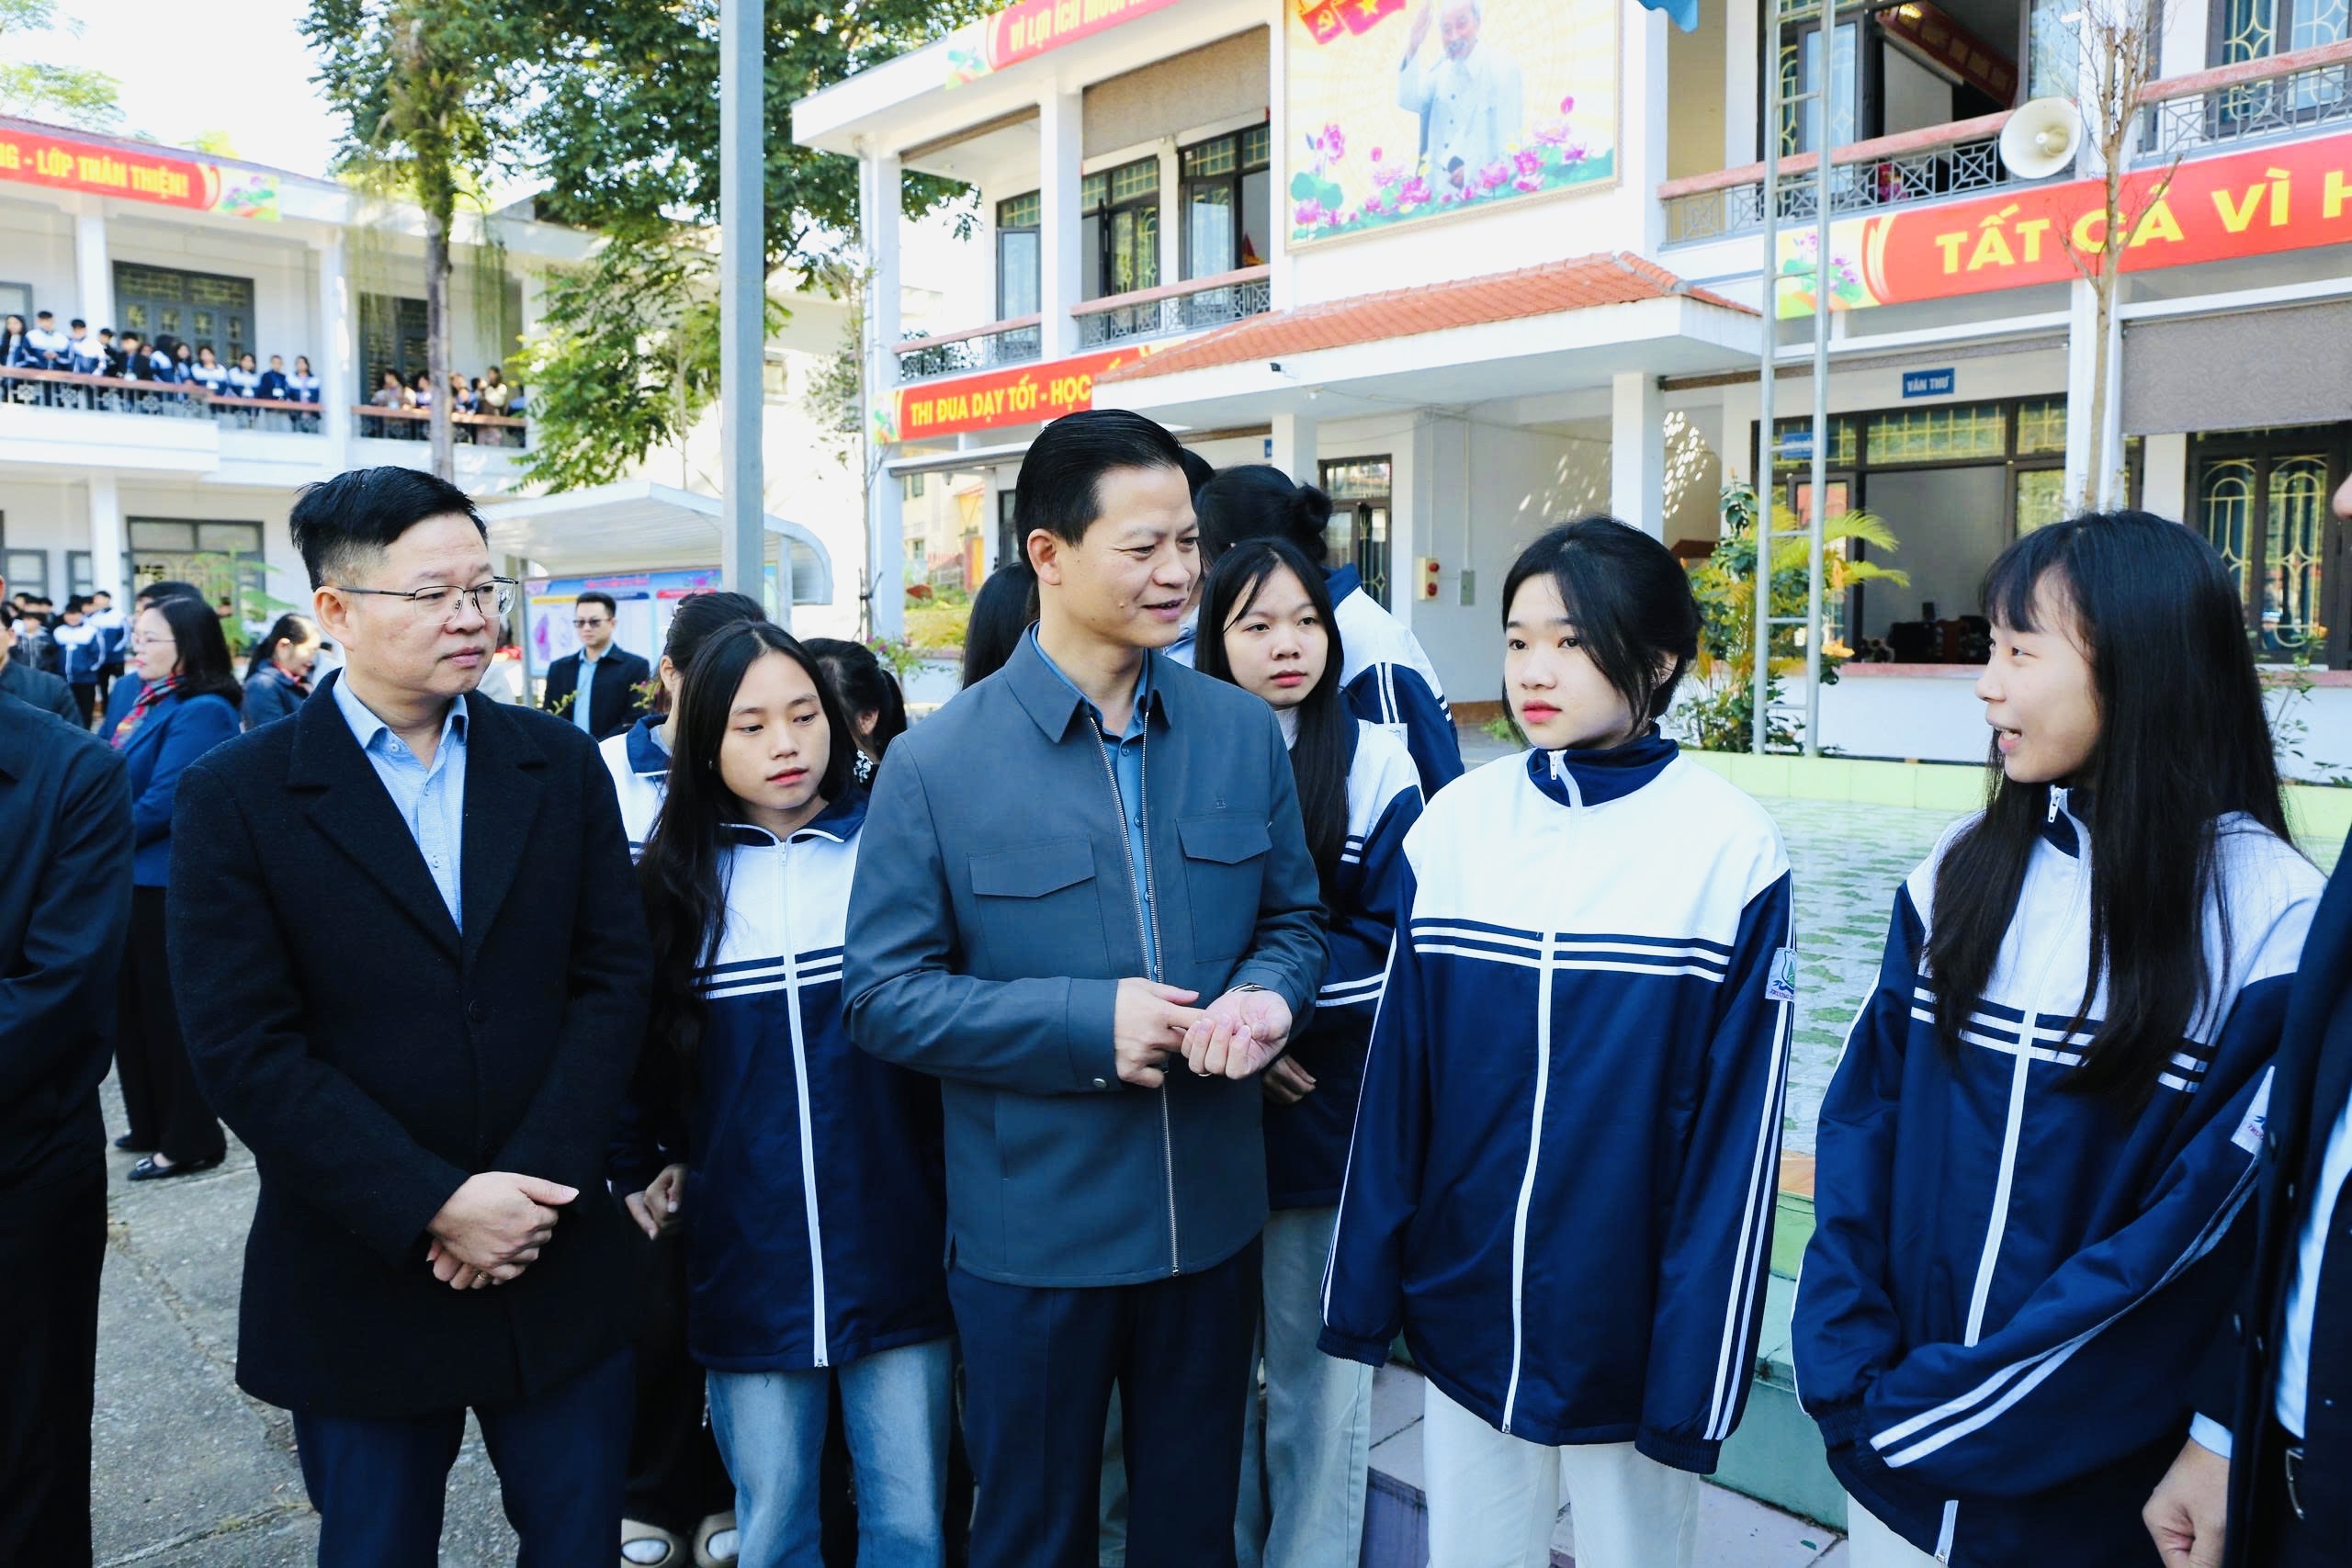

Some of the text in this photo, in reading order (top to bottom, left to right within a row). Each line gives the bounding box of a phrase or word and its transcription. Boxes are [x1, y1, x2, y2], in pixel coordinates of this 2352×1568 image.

[37, 147, 74, 177] LỚP
[76, 155, 129, 187] THÂN
[1934, 203, 2051, 275] TẤT
[2071, 184, 2186, 254] CẢ
[2211, 167, 2292, 234] VÌ
[910, 397, 933, 426] THI
[936, 394, 968, 423] ĐUA
[972, 389, 1005, 423] DẠY
[1009, 373, 1038, 410] TỐT
[1050, 374, 1092, 412] HỌC
